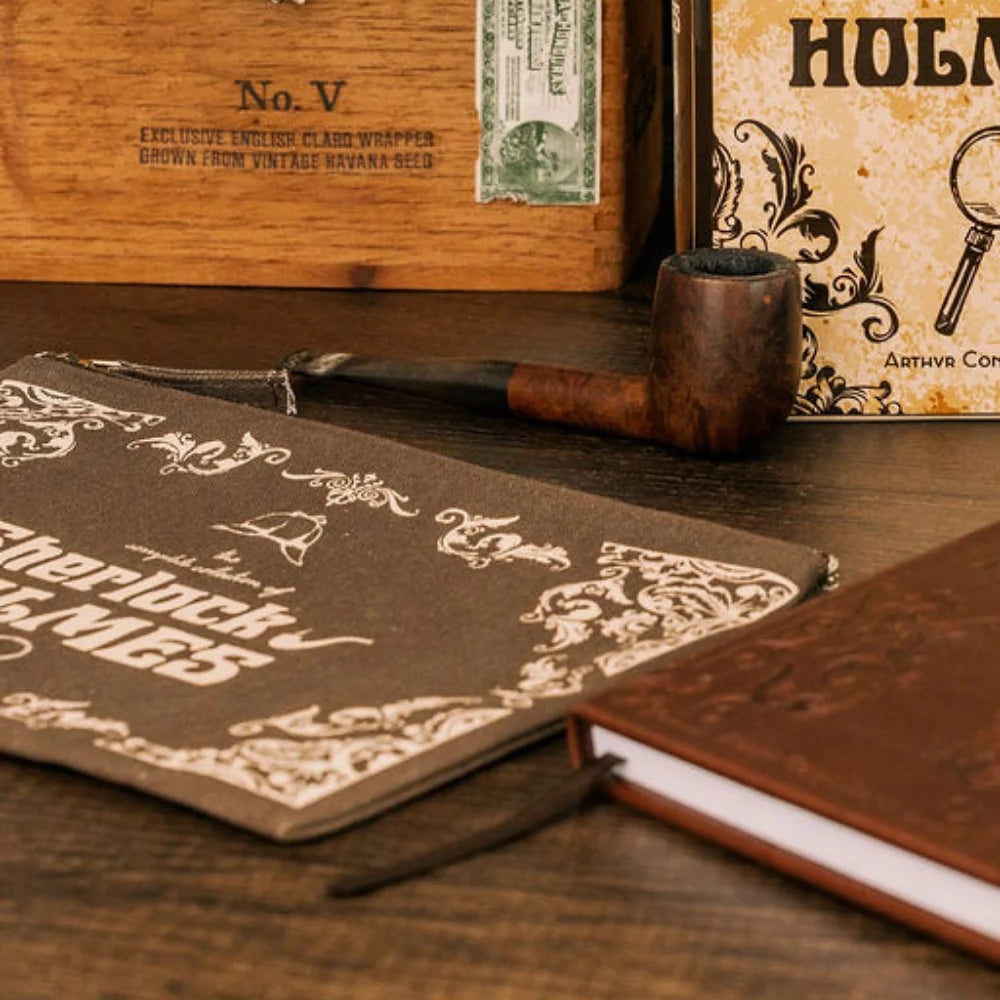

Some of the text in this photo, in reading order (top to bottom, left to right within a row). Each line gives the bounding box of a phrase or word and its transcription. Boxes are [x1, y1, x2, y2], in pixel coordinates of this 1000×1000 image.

[234, 79, 347, 112] No. V
[139, 126, 225, 146] EXCLUSIVE
[231, 129, 295, 148] ENGLISH
[358, 130, 435, 148] WRAPPER
[138, 147, 434, 169] GROWN FROM VINTAGE HAVANA SEED
